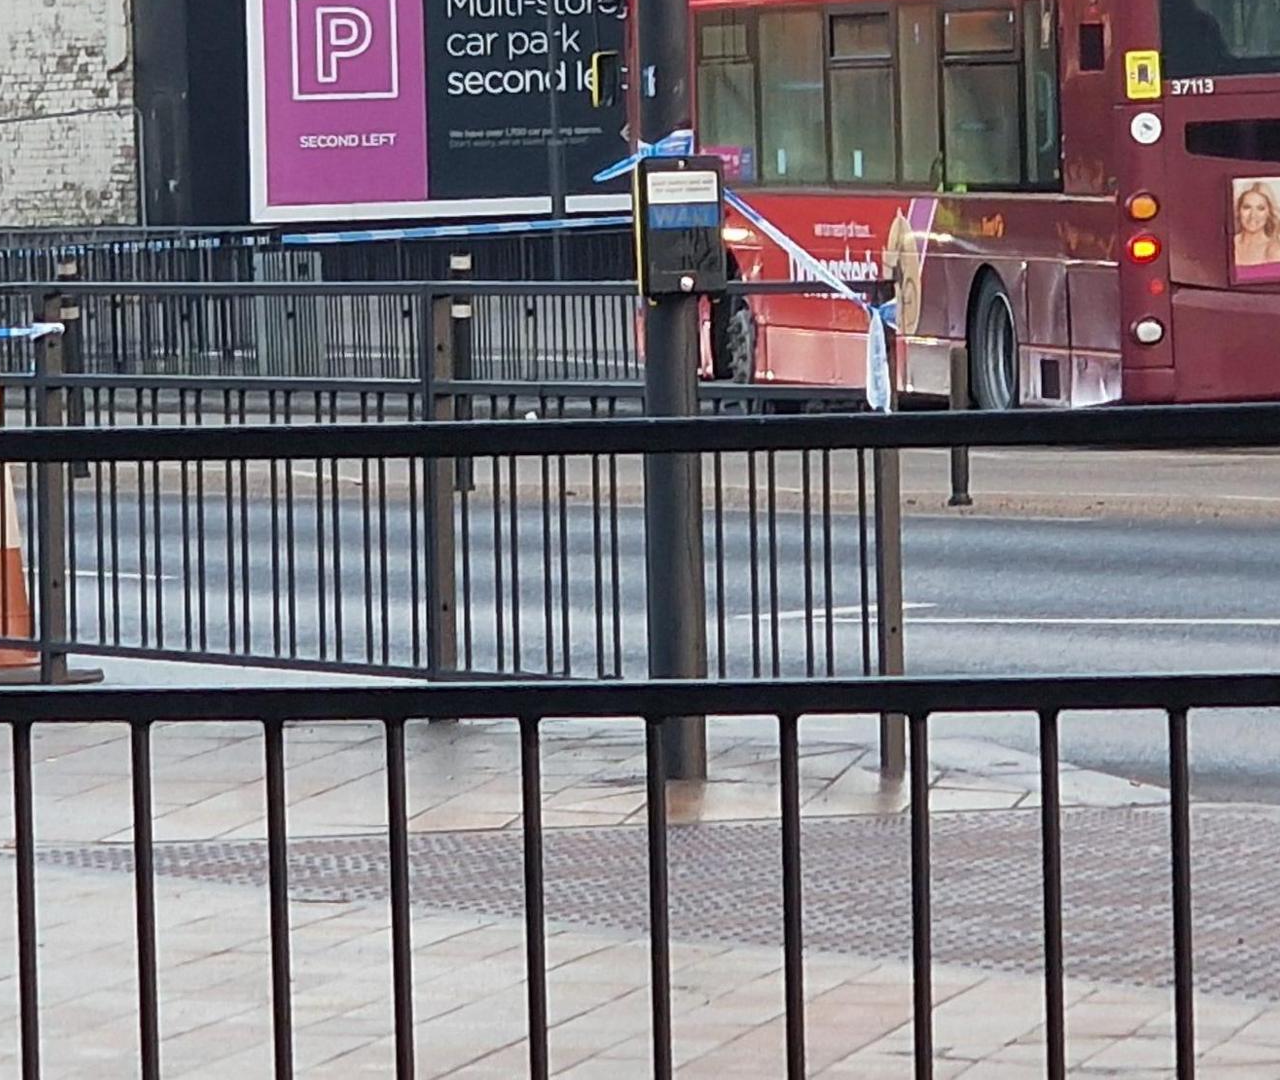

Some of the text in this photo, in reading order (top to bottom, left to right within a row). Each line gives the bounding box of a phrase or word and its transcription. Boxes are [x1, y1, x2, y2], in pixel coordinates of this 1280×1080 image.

[316, 6, 373, 83] P
[447, 22, 581, 61] car pak
[447, 60, 628, 95] second le
[1171, 78, 1215, 95] 37113
[300, 132, 396, 148] SECOND LEFT
